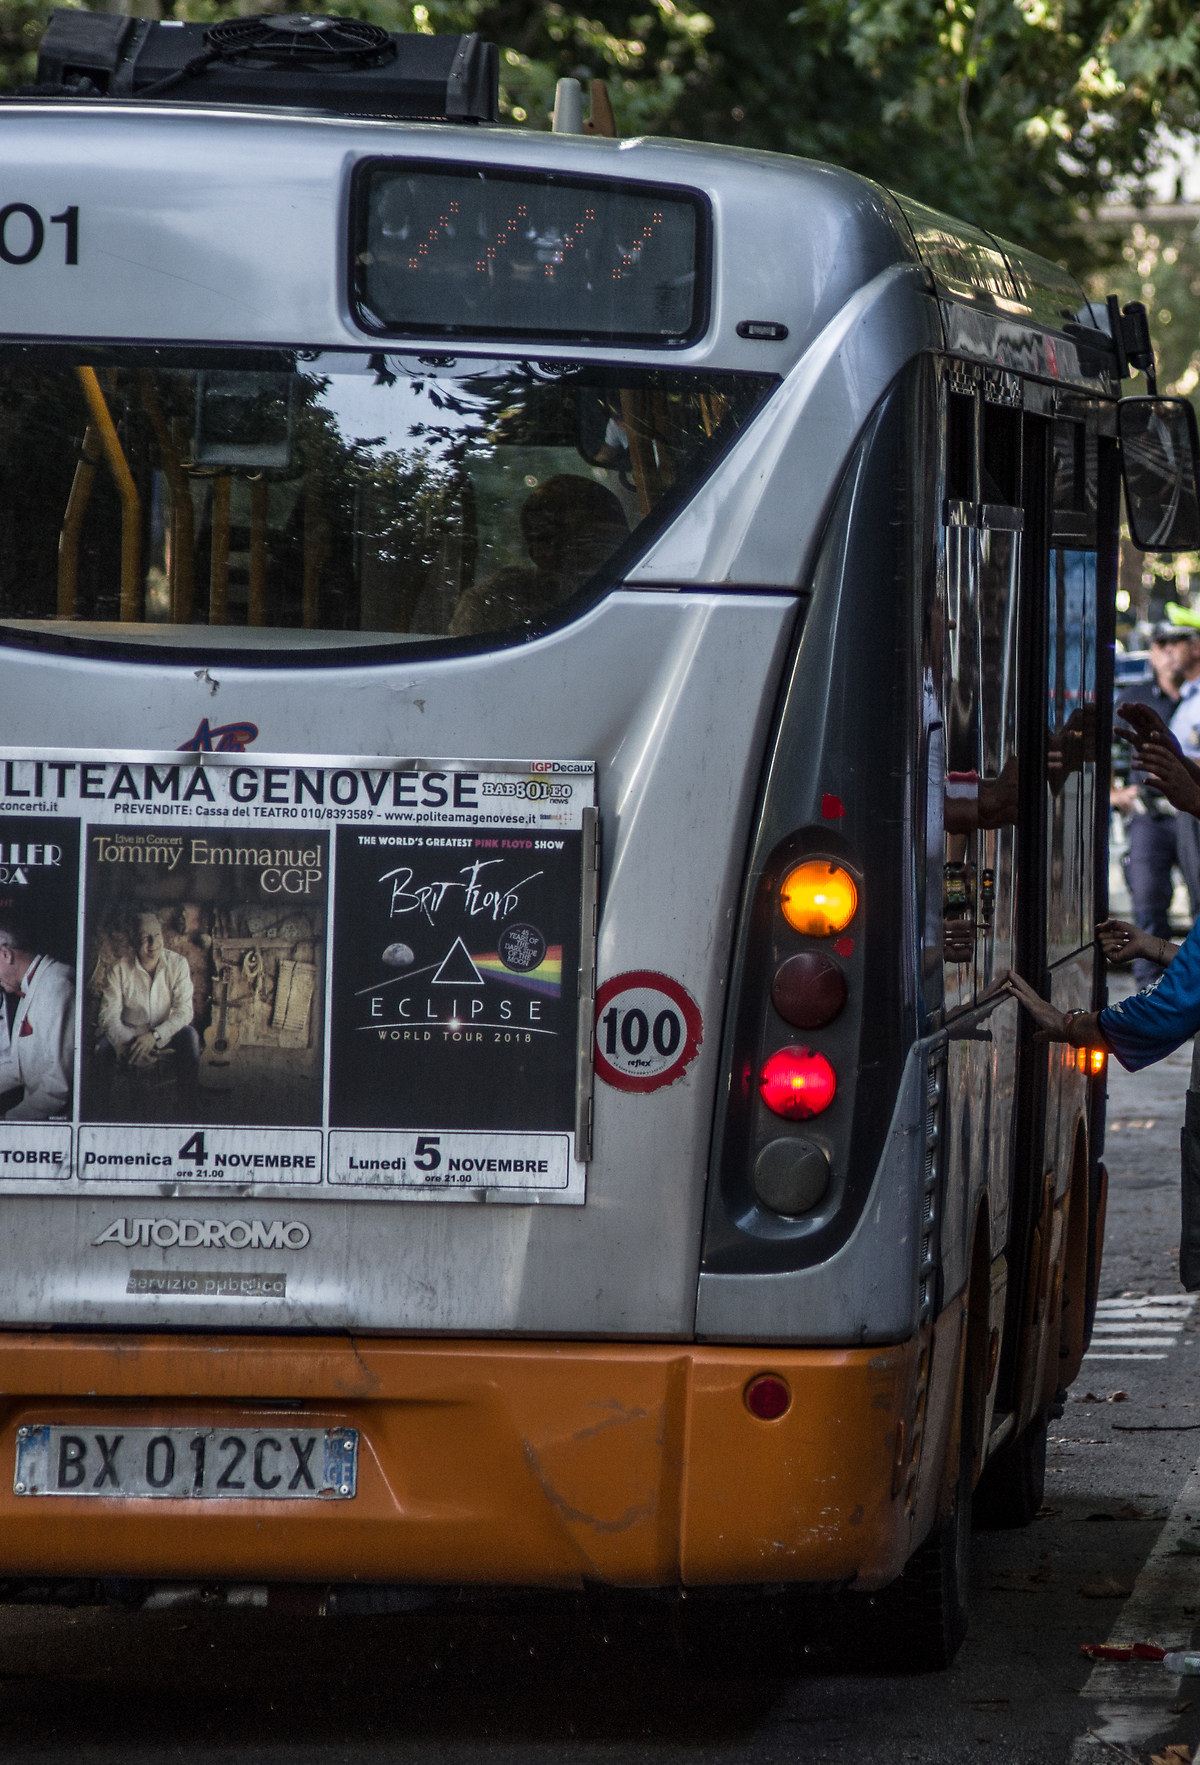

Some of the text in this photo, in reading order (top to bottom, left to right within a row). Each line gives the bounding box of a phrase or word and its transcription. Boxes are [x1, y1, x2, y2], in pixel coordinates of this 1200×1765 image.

[532, 762, 594, 773] IGPDecaux
[5, 761, 479, 809] LITEAMA GENOVESE
[114, 803, 192, 816] PREVENDITE:
[195, 805, 229, 817] Cassa
[232, 805, 250, 817] del
[254, 807, 298, 818] TEATRO
[301, 808, 373, 821] 010/8393589
[385, 811, 536, 826] www.politeamagenovese.it
[115, 834, 183, 846] Live in Concert
[358, 836, 565, 850] THE WORLD'S GREATEST PINK FLOYD SHOW
[92, 837, 321, 871] Tommy Emmanuel
[260, 868, 323, 894] CGP
[371, 998, 542, 1020] ECLIPSE
[378, 1030, 532, 1043] WORLD TOUR 2018
[603, 1008, 680, 1056] 100
[628, 1059, 652, 1068] reflex
[0, 1151, 63, 1163] TOBRE
[85, 1131, 316, 1168] Domenica 4 NOVEMBRE
[349, 1136, 548, 1173] Lunedì 5 NOVEMBRE
[176, 1169, 224, 1178] ore 21.00
[425, 1174, 472, 1183] ore 21.00
[91, 1218, 311, 1250] AUTODROMO
[127, 1276, 198, 1290] servizio
[57, 1435, 317, 1490] BX 012CX
